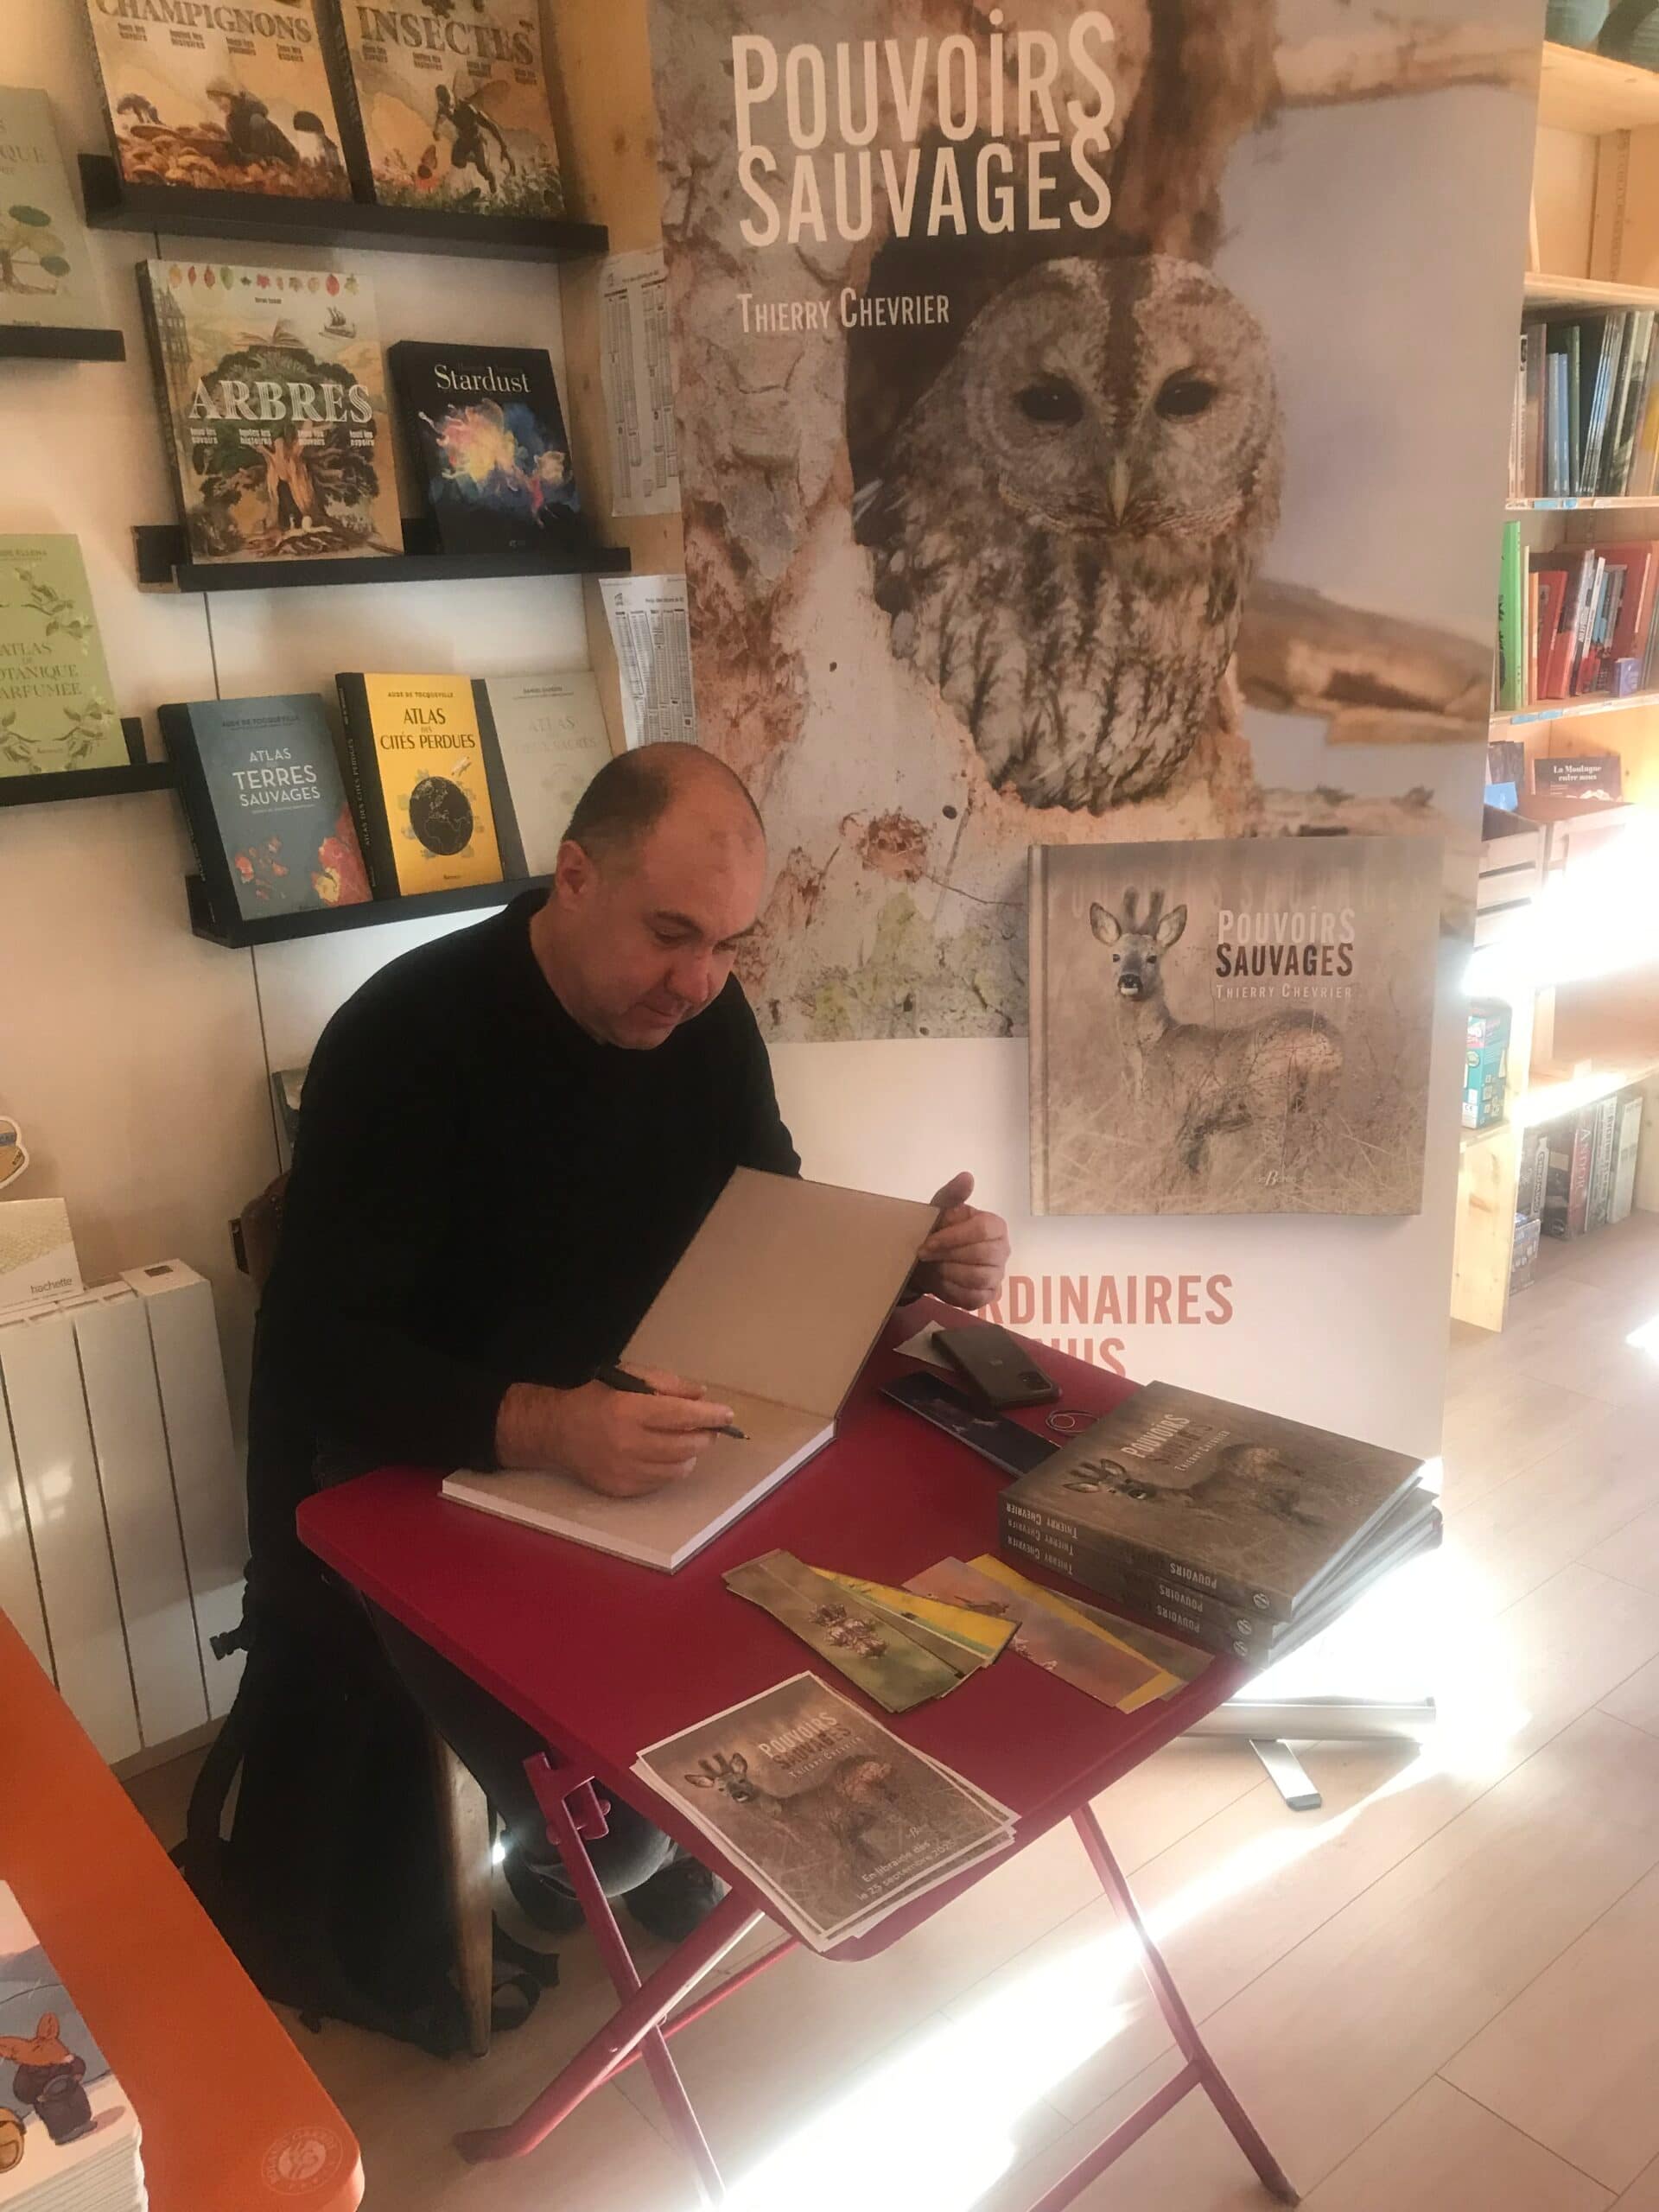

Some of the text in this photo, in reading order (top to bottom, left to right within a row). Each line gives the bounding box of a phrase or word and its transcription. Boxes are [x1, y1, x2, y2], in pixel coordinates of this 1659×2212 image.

[97, 0, 312, 43] CHAMPIGNONS
[356, 6, 533, 66] INSECTES
[738, 132, 1112, 247] SAUVAGES
[736, 287, 950, 333] THIERRY CHEVRIER
[434, 364, 532, 394] Stardust
[188, 378, 373, 423] ARBRES
[404, 708, 446, 724] ATLAS
[249, 747, 292, 763] ATLAS
[380, 731, 476, 750] CITÉS PERDUES
[232, 765, 317, 791] TERRES
[239, 786, 321, 807] SAUVAGES
[1216, 942, 1354, 978] SAUVAGES
[1216, 983, 1352, 1000] THIERRY CHEVRIER
[30, 1277, 73, 1294] hachette
[1006, 1503, 1079, 1540] THIERRY CHEVRIER
